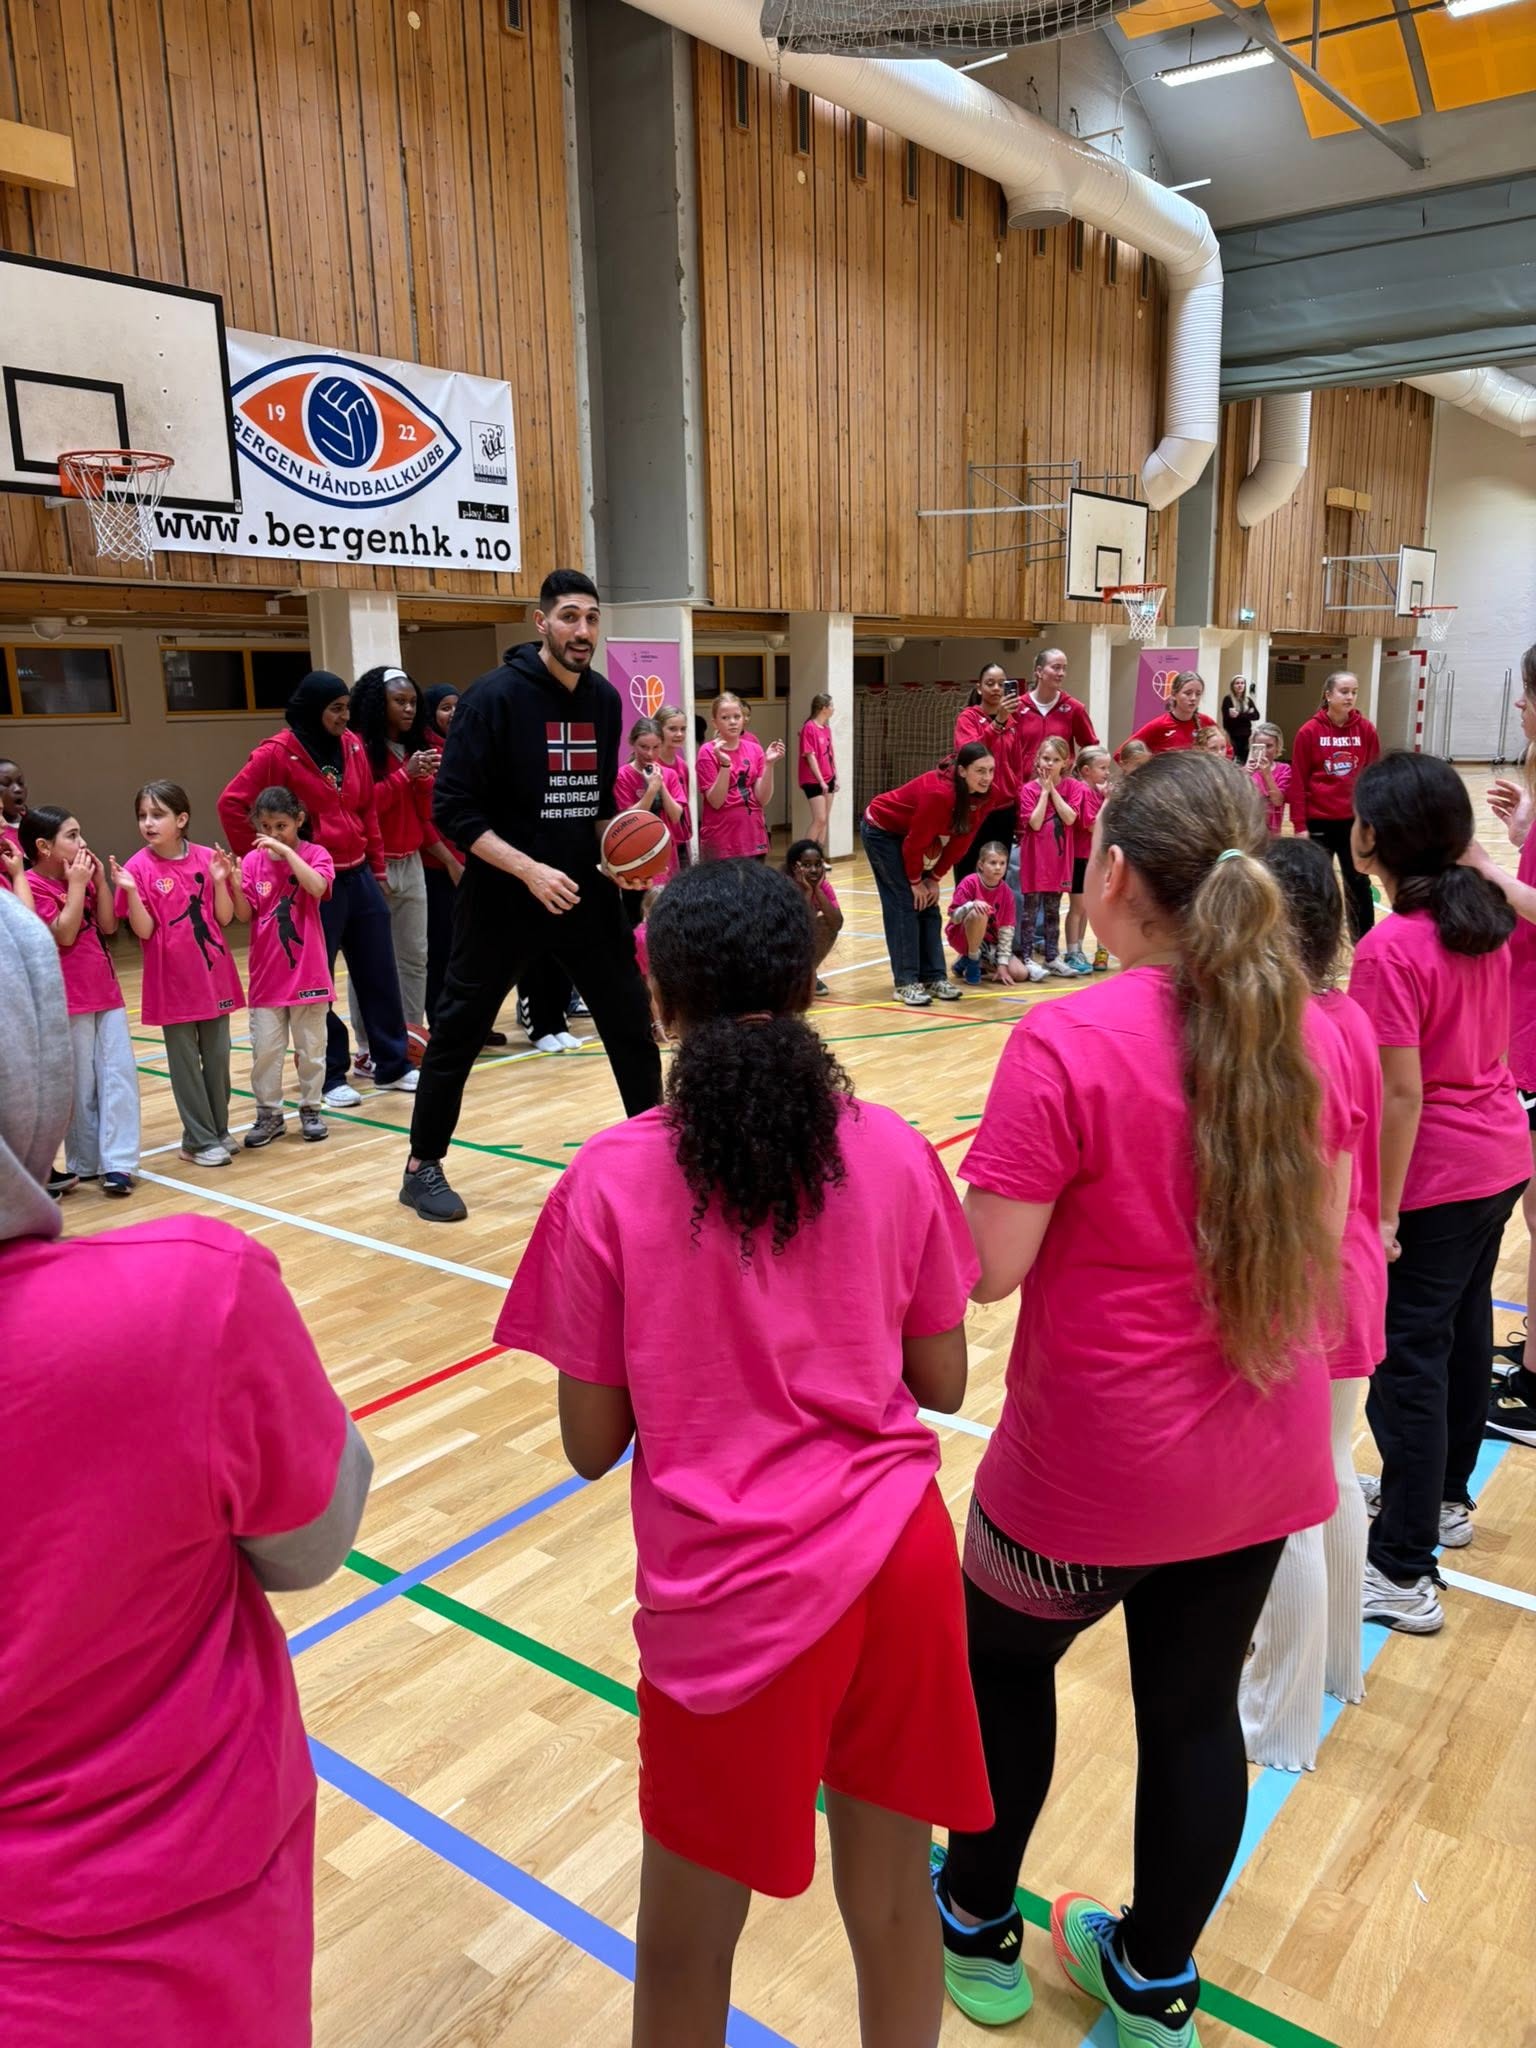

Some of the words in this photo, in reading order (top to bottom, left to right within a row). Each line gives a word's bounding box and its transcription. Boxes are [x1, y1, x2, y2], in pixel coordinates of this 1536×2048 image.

[267, 403, 286, 421] 19
[398, 423, 417, 441] 22
[231, 414, 303, 480] BERGEN
[307, 444, 445, 496] HÅNDBALLKLUBB
[153, 511, 511, 562] www.bergenhk.no
[549, 775, 568, 787] HER
[569, 775, 599, 786] GAME
[544, 792, 566, 804] HER
[540, 808, 562, 819] HER
[611, 815, 639, 839] molten
